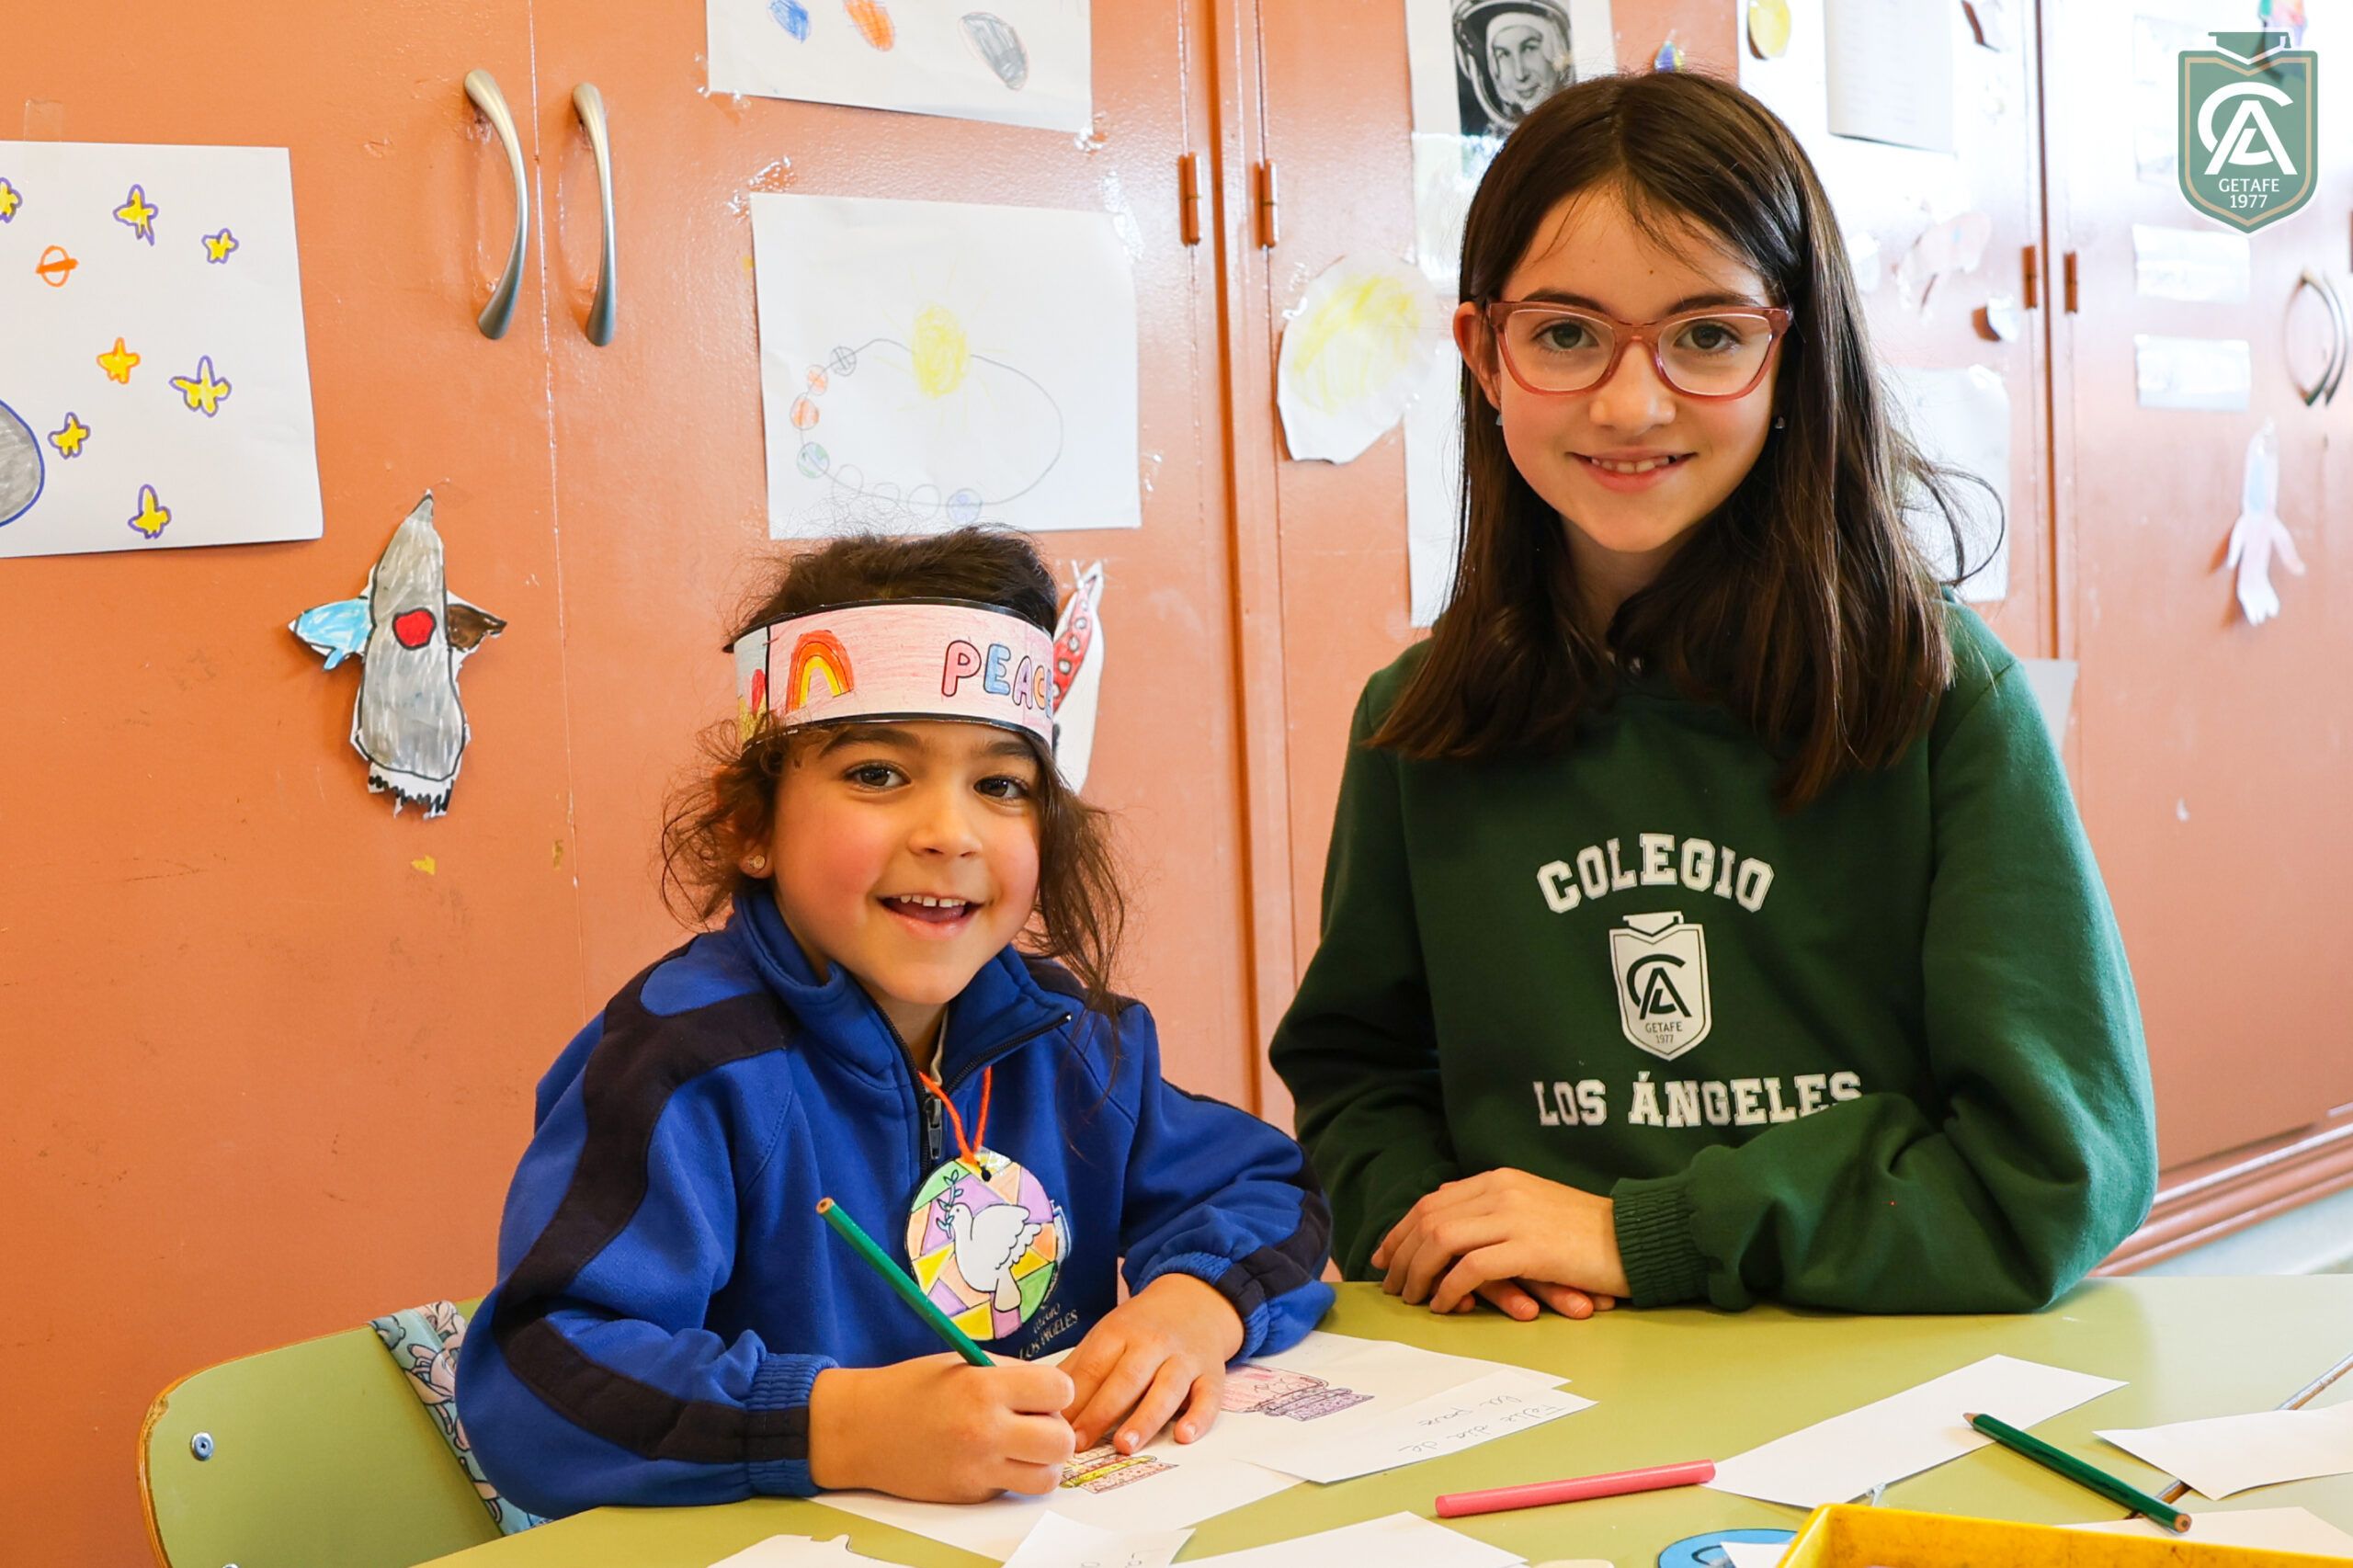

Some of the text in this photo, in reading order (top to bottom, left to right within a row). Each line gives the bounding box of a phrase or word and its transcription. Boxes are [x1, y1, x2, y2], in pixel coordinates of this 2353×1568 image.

[1536, 832, 1775, 914] COLEGIO
[1645, 1021, 1682, 1033] GETAFE
[1655, 1034, 1674, 1044] 1977
[1532, 1078, 1607, 1126] LOS
